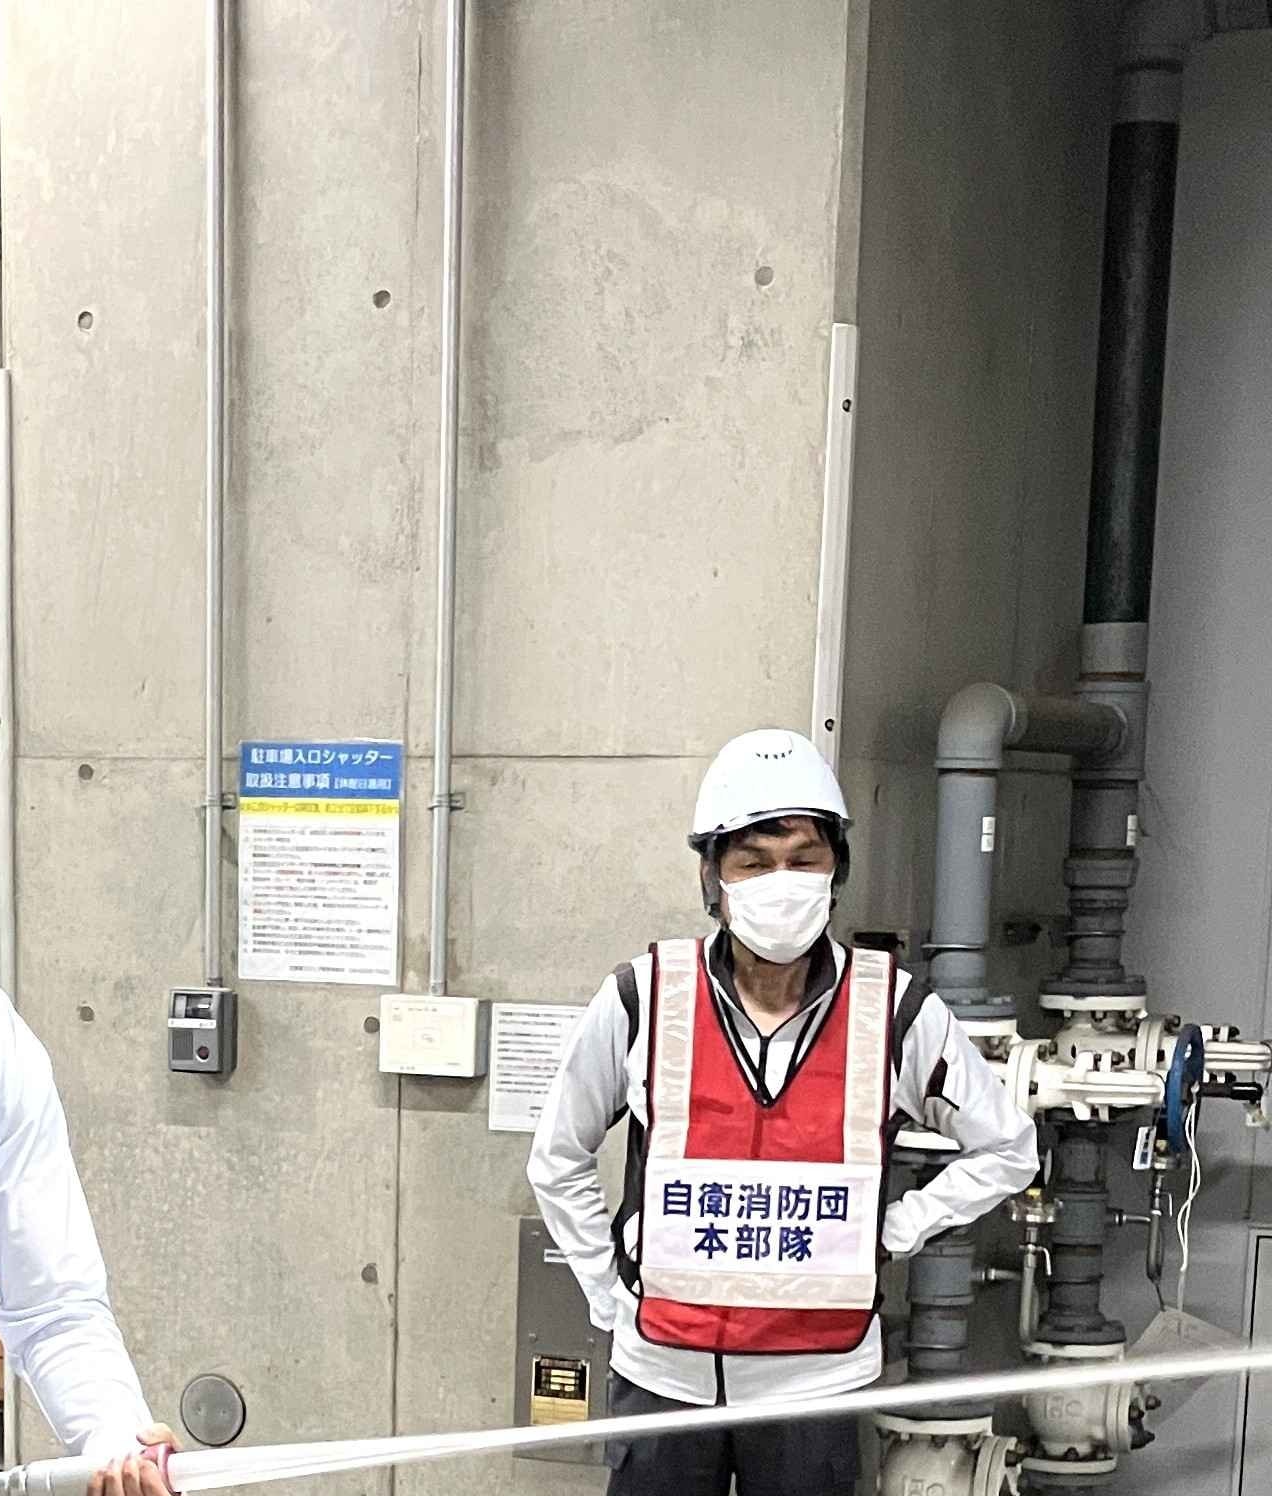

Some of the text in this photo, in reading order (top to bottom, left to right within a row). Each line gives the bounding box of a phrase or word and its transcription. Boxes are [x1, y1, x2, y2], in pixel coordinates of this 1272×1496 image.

[250, 748, 393, 765] 駐車場入口シャッター
[245, 772, 330, 790] 取扱注意事項
[663, 1180, 849, 1222] 自衛消防団
[693, 1222, 814, 1261] 本部隊
